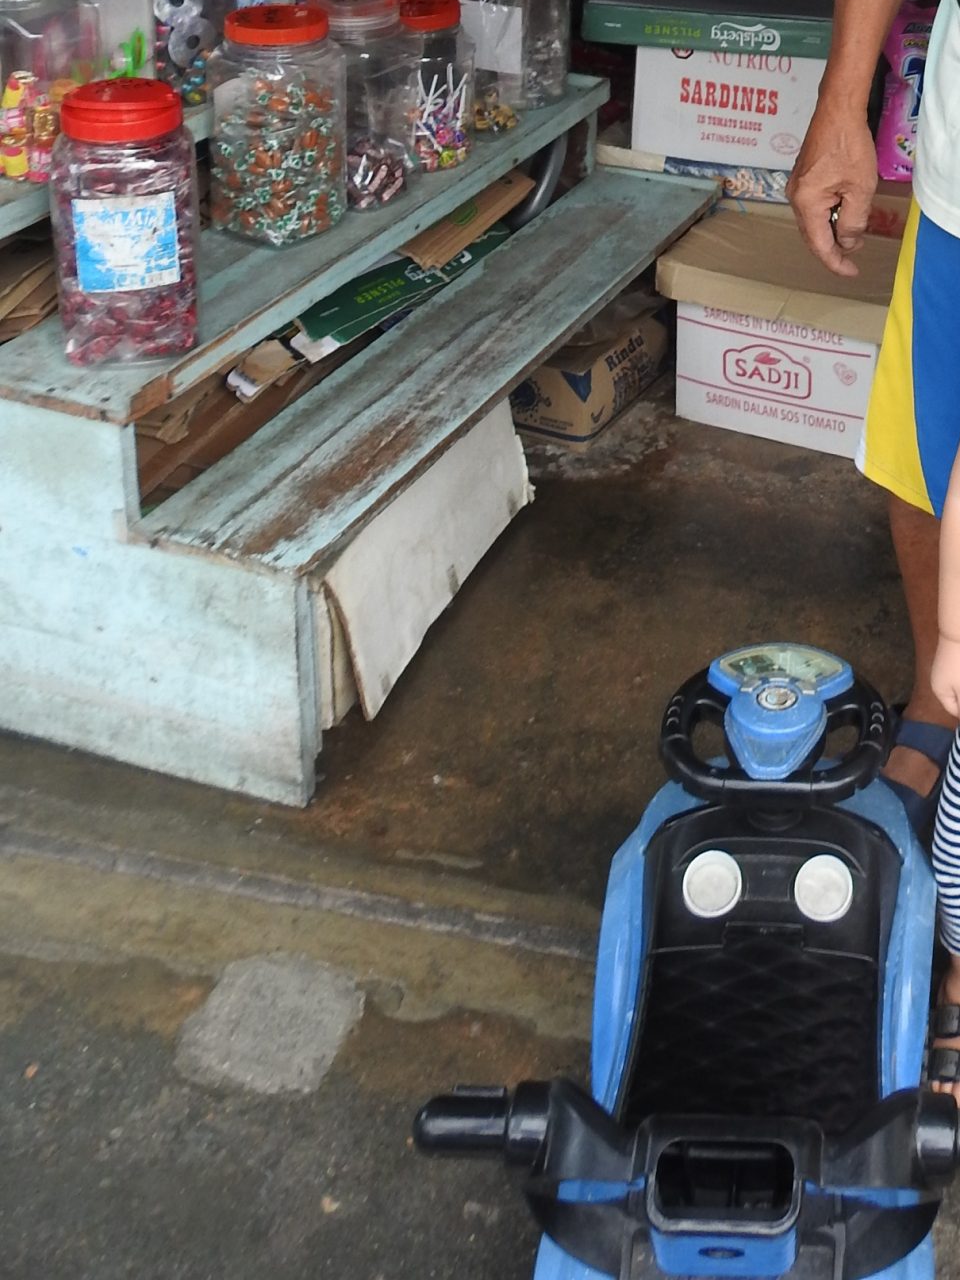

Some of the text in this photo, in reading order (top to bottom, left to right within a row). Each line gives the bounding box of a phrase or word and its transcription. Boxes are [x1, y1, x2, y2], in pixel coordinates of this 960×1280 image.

[643, 22, 781, 51] Carlsberg PILSNER
[680, 78, 778, 115] SARDINES
[707, 116, 737, 129] TOMATO
[703, 306, 845, 346] SARDINES IN TOMATO SAUCE
[604, 332, 645, 372] Rindu
[735, 358, 800, 390] SADJI
[705, 391, 846, 433] SARDIN DALAM SOS TOMATO
